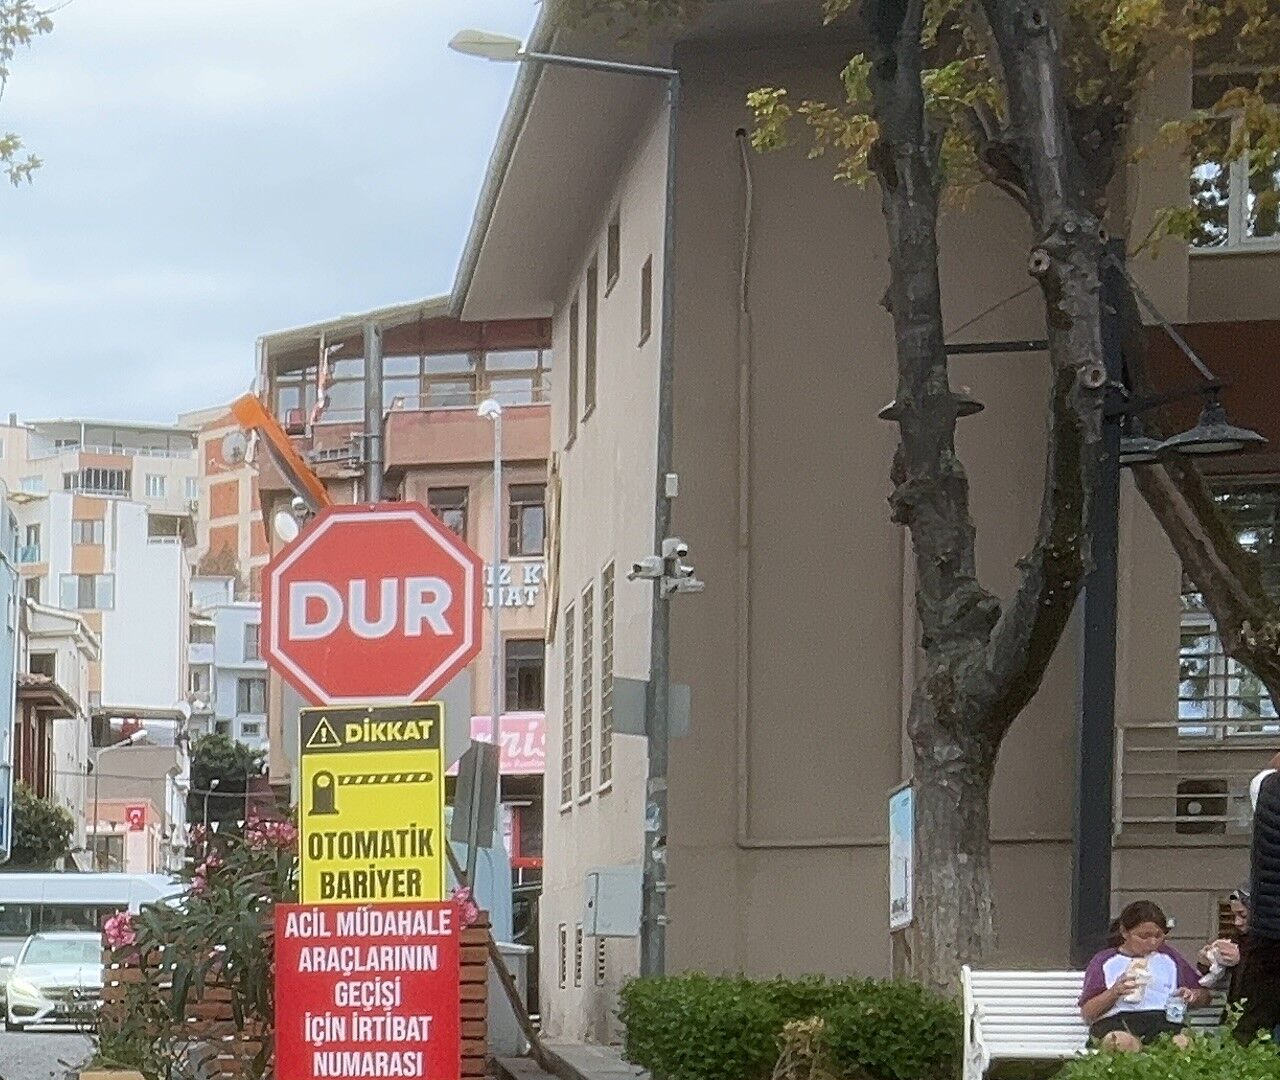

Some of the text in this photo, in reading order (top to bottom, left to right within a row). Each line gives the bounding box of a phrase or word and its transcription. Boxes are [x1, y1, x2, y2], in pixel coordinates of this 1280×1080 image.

[289, 576, 453, 641] DUR
[345, 717, 434, 744] DİKKAT
[308, 823, 433, 861] OTOMATİK
[320, 864, 422, 899] BARİYER
[284, 907, 453, 938] ACİL MÜDAHALE
[298, 944, 438, 976] ARAÇLARININ
[334, 976, 402, 1011] GEÇİŞİ
[304, 1011, 433, 1046] İÇİN İRTİBAT
[313, 1051, 423, 1078] NUMARASI
